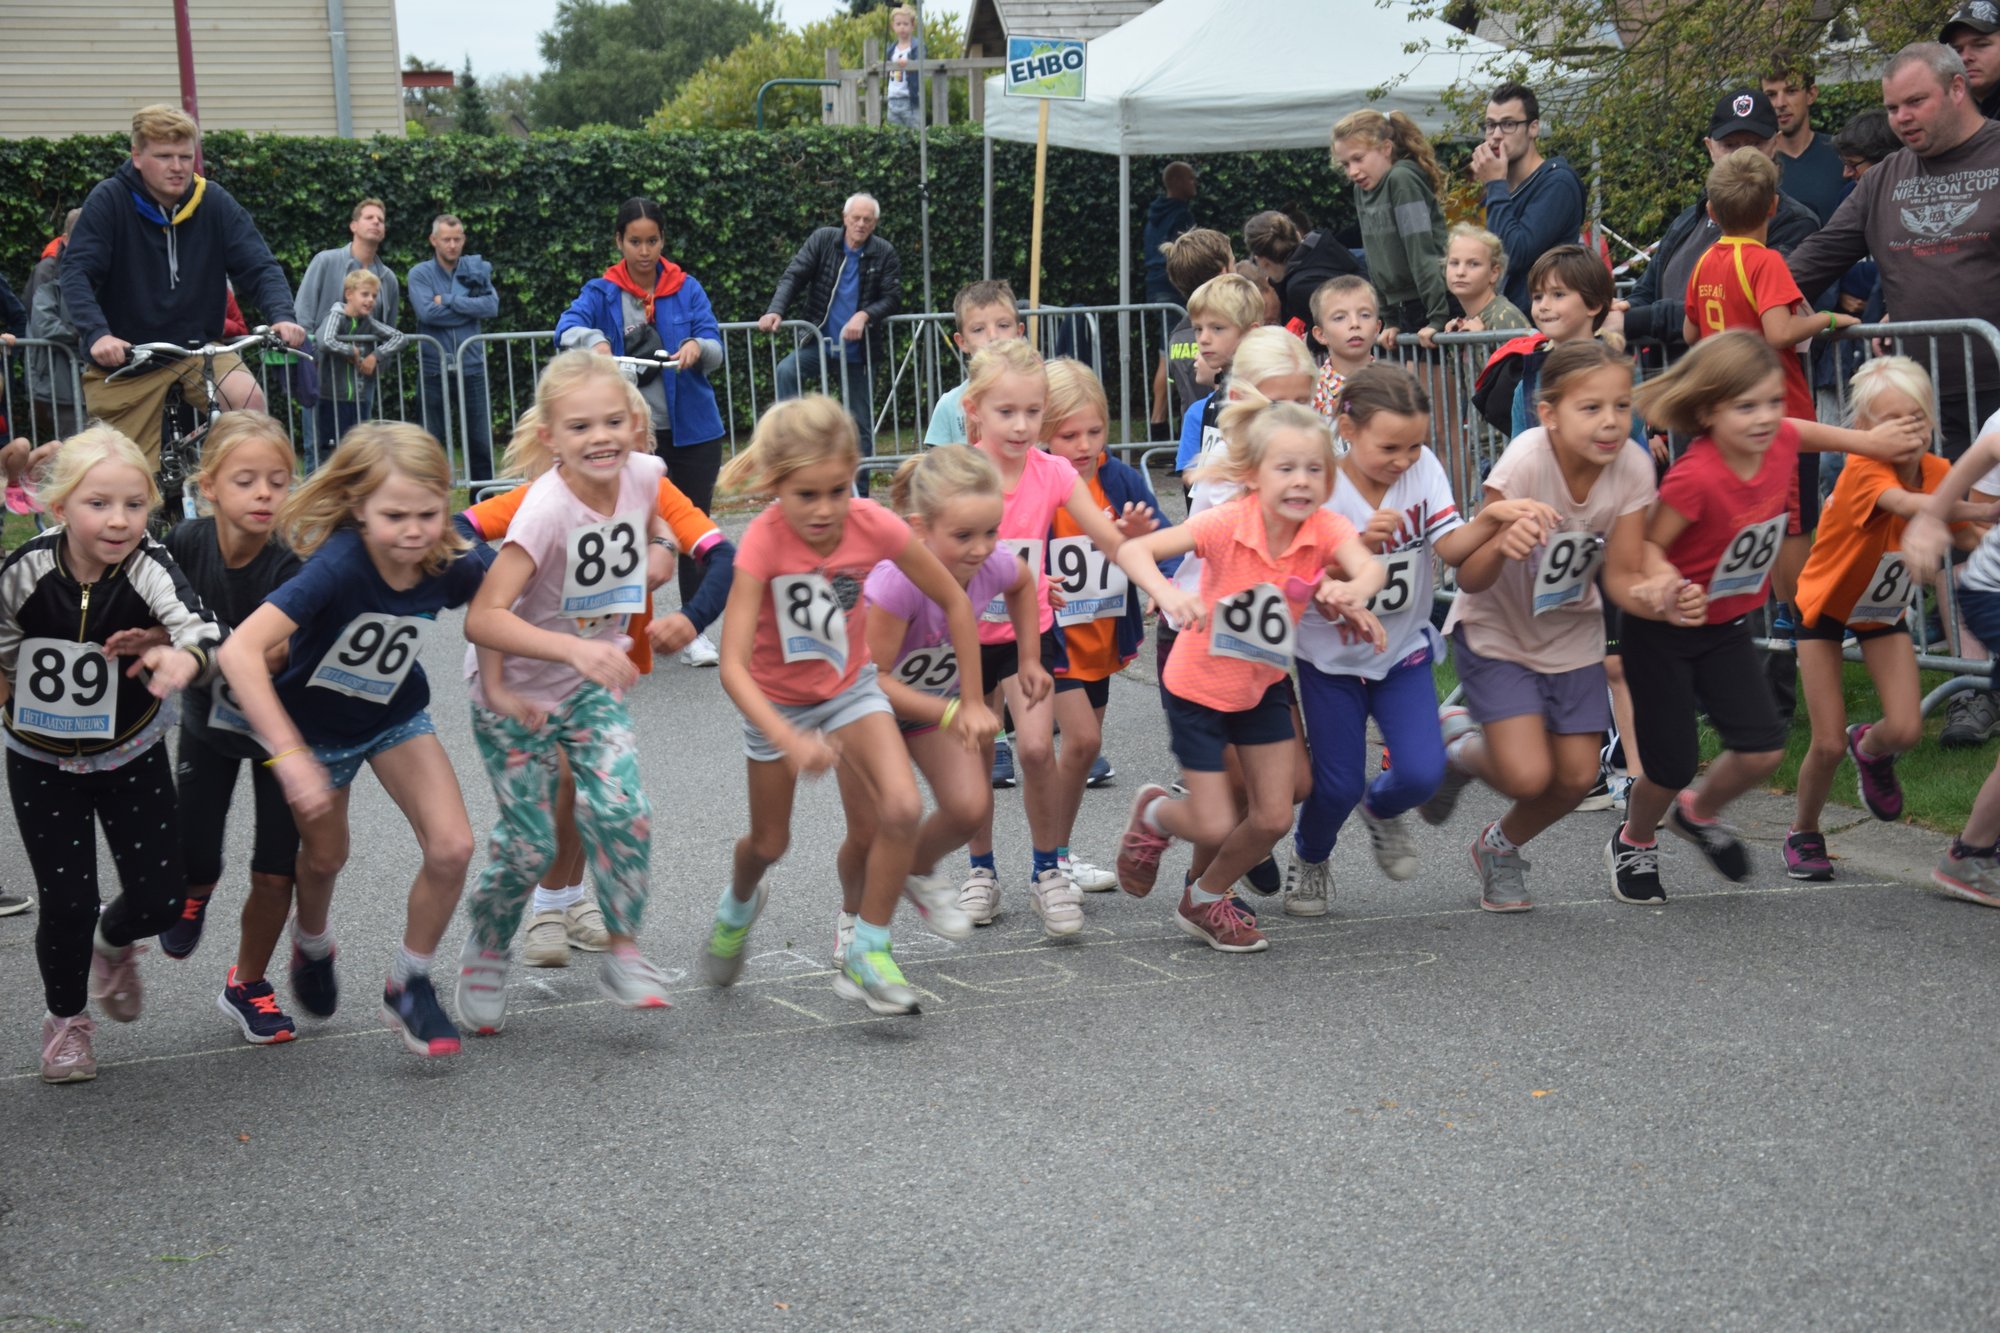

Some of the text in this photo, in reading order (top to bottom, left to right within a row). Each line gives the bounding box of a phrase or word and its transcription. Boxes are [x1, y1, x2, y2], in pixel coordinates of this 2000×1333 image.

[1010, 48, 1084, 84] EHBO
[1947, 167, 2000, 182] OUTDOOR
[1965, 177, 1999, 192] CUP
[574, 522, 639, 587] 83
[1058, 544, 1111, 594] 97
[1544, 537, 1599, 585] 93
[1723, 524, 1777, 573] 98
[1366, 561, 1409, 611] 5
[1224, 589, 1287, 646] 86
[338, 621, 418, 675] 96
[901, 652, 957, 687] 95
[29, 647, 108, 707] 89
[23, 709, 105, 731] HET LAATSTE NIEUWS
